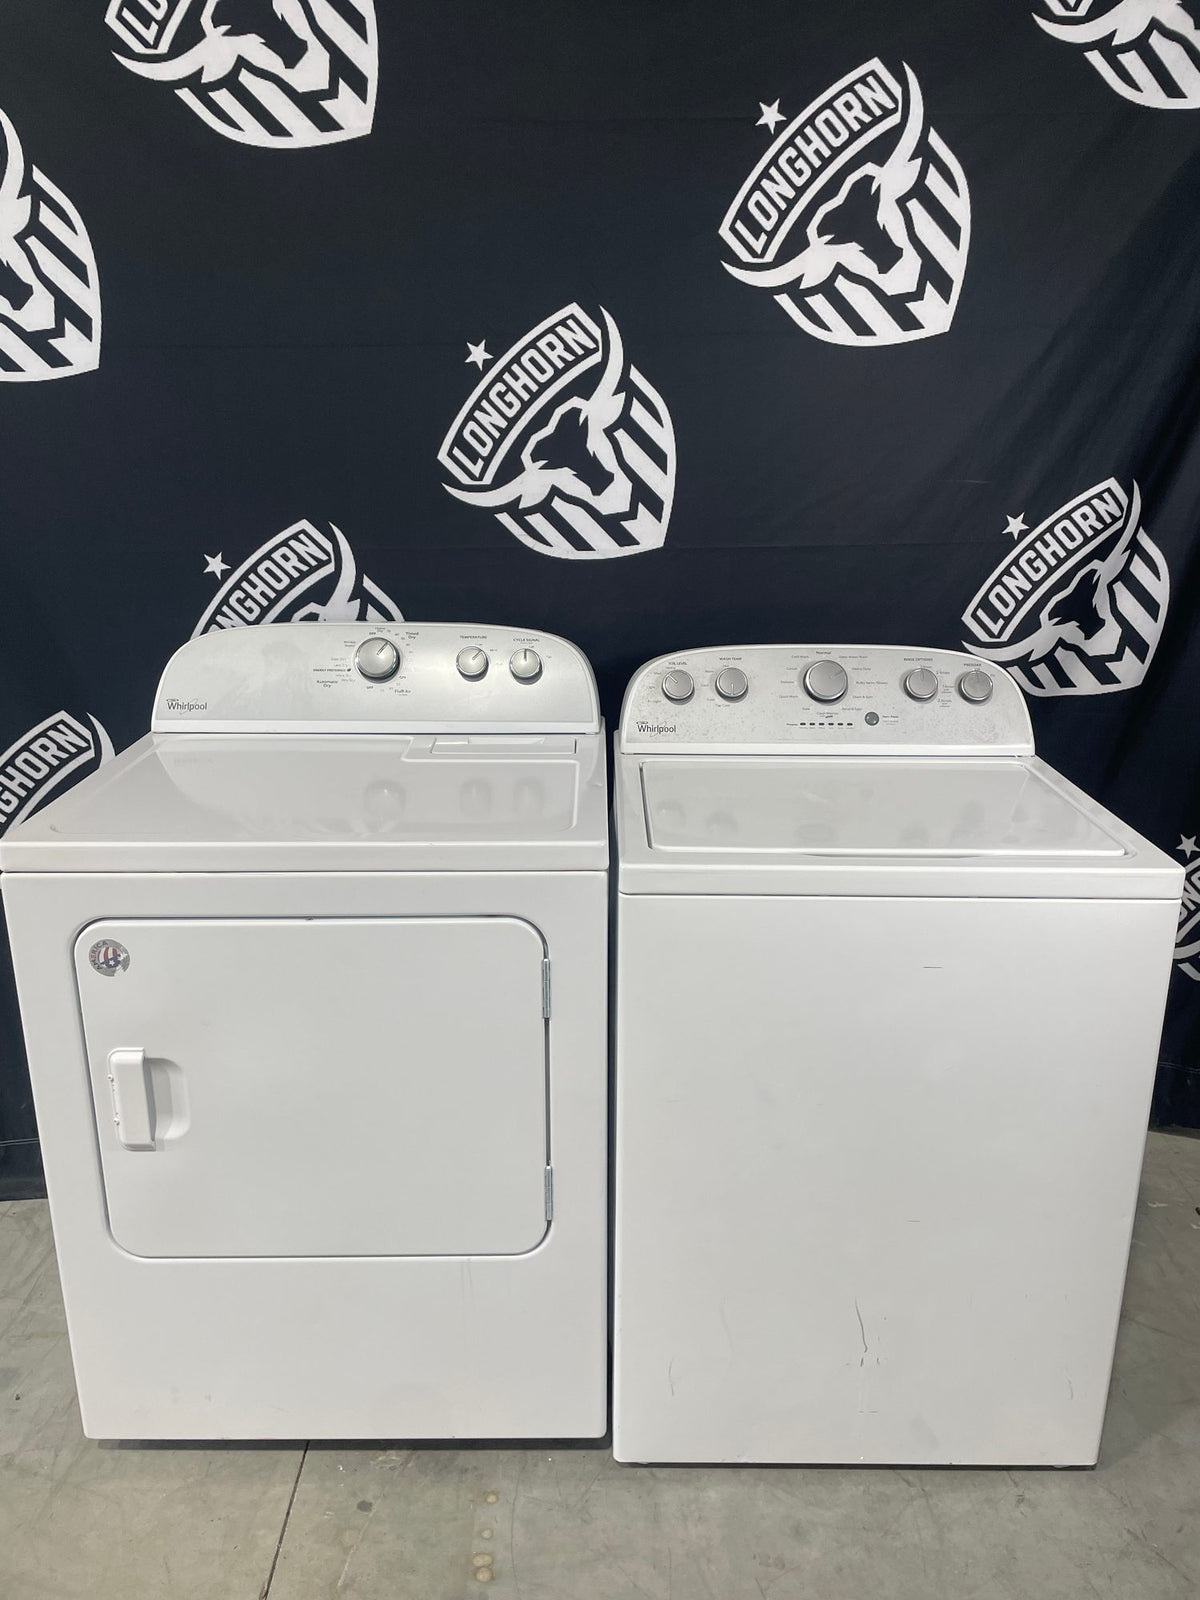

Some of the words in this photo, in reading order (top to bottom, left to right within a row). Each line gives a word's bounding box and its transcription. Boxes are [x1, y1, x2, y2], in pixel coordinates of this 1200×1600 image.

[734, 75, 897, 255] LONGHORN
[452, 318, 597, 478] LONGHORN
[207, 533, 330, 634] NGHORN
[975, 491, 1123, 636] LONGHORN
[167, 702, 207, 712] Whirlpool
[637, 725, 677, 735] Whirlpool
[0, 723, 89, 824] GHORN
